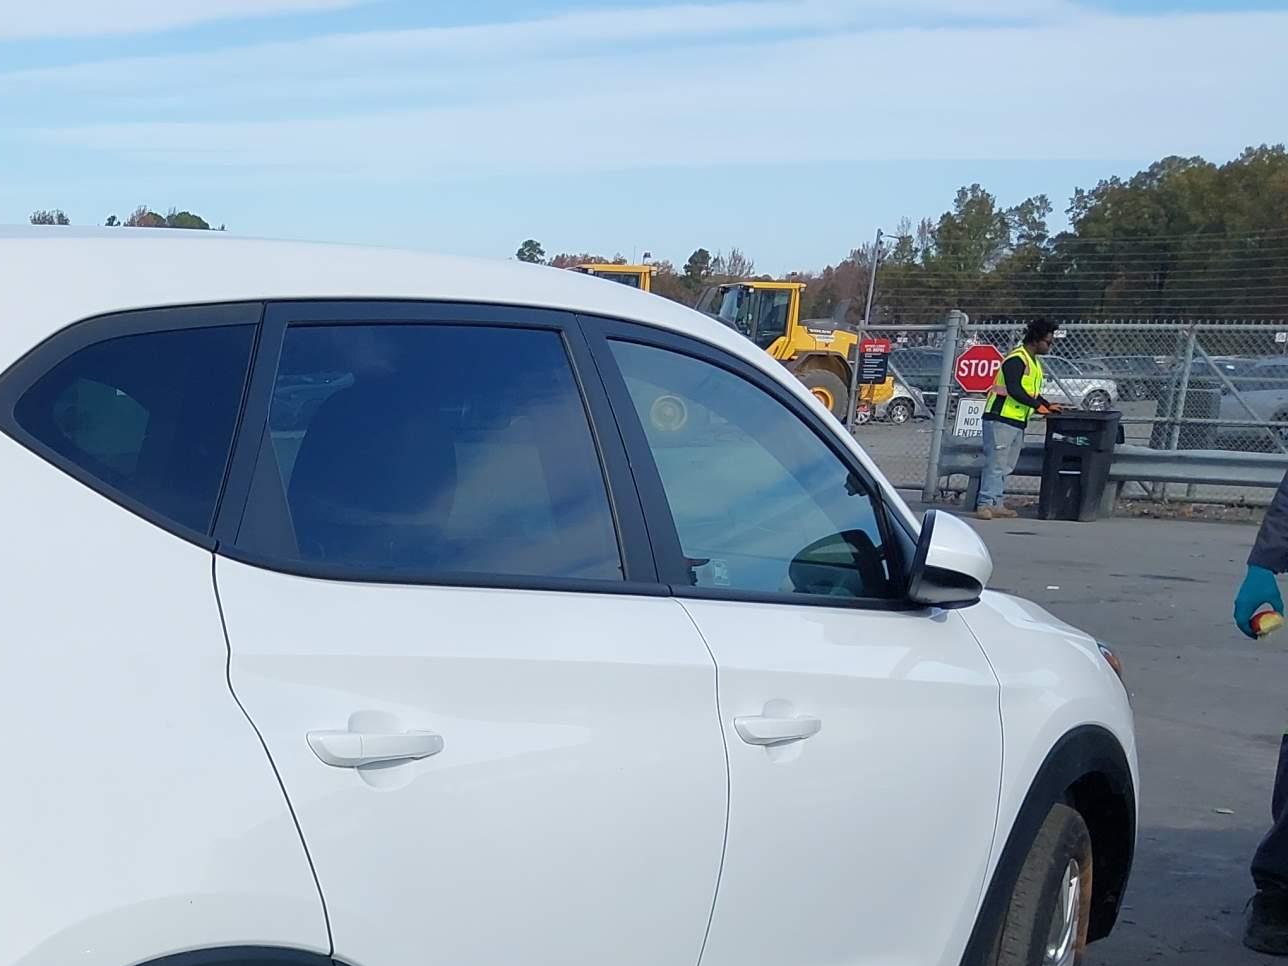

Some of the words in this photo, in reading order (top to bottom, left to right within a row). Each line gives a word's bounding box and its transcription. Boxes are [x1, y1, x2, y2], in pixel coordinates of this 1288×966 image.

[958, 359, 1002, 377] STOP
[967, 406, 980, 415] DO
[963, 417, 980, 426] NOT
